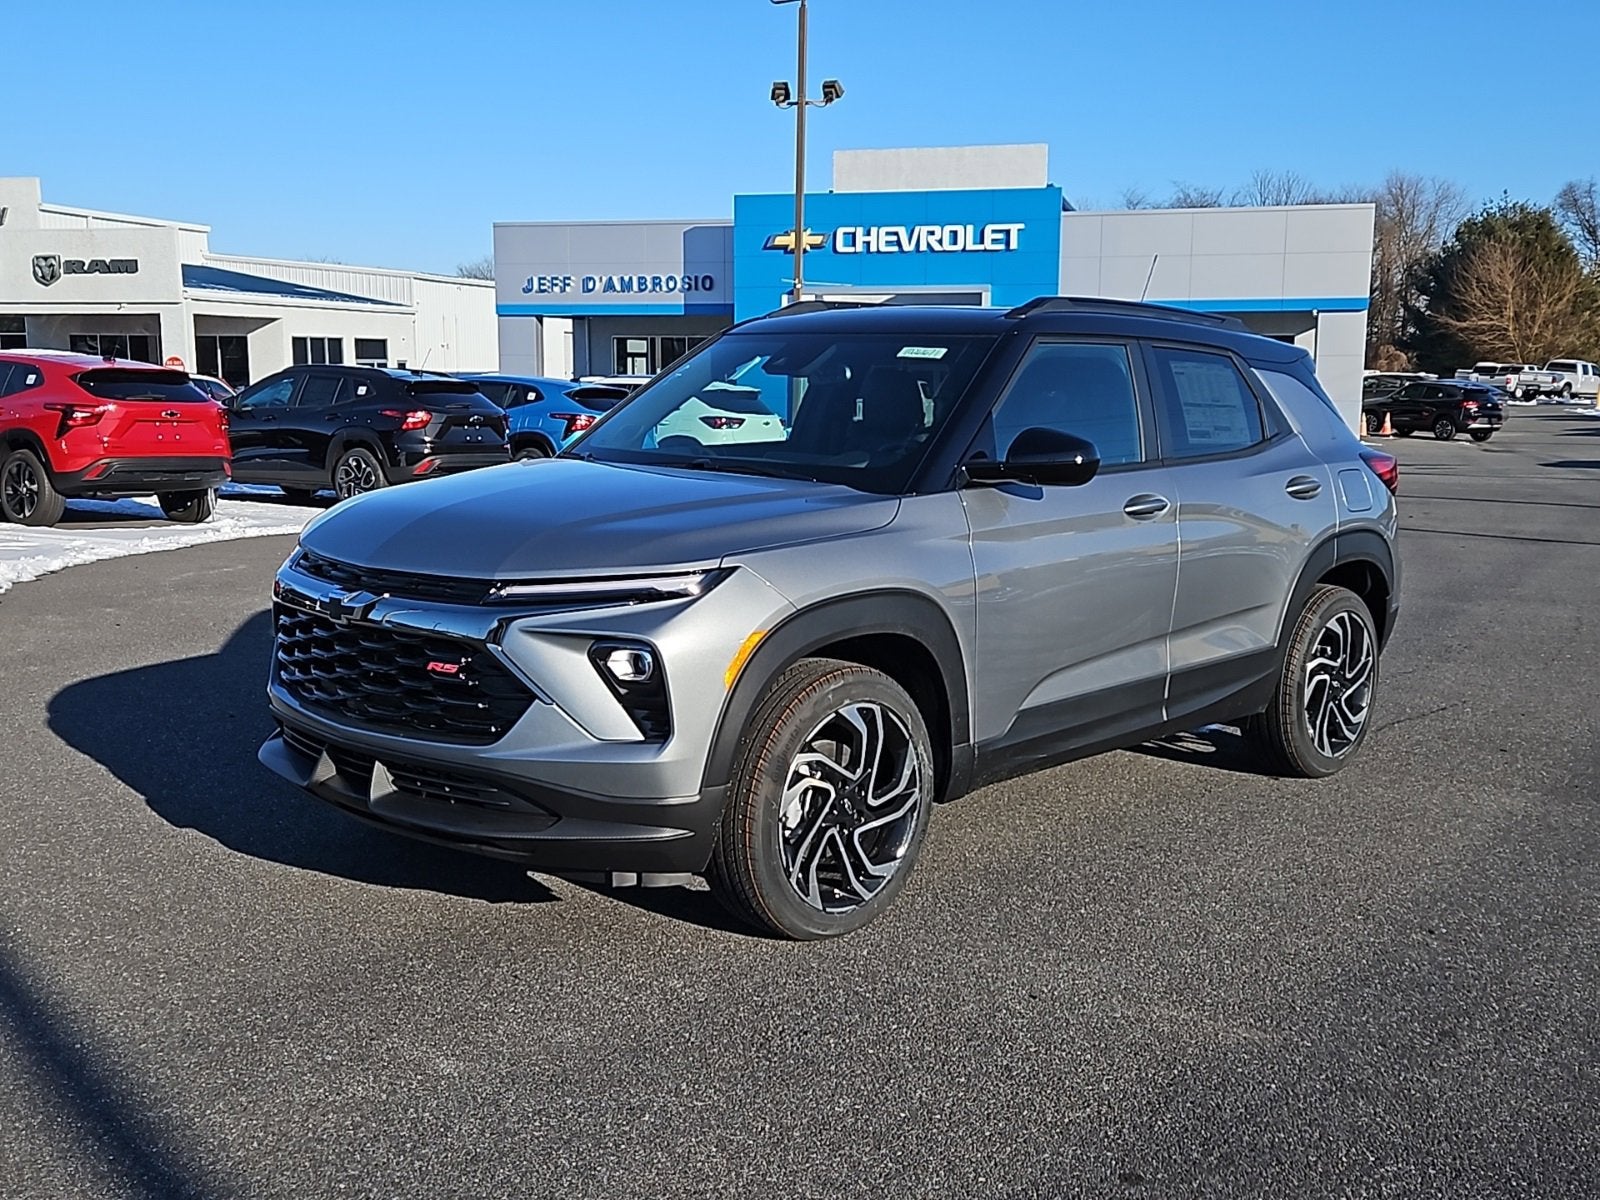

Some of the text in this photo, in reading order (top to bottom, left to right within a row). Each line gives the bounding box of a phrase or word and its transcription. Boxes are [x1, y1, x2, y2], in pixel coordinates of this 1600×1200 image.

[834, 223, 1025, 253] CHEVROLET
[63, 259, 138, 274] RAM
[522, 275, 714, 294] JEFF D'AMBROSIO
[427, 661, 459, 673] RS
